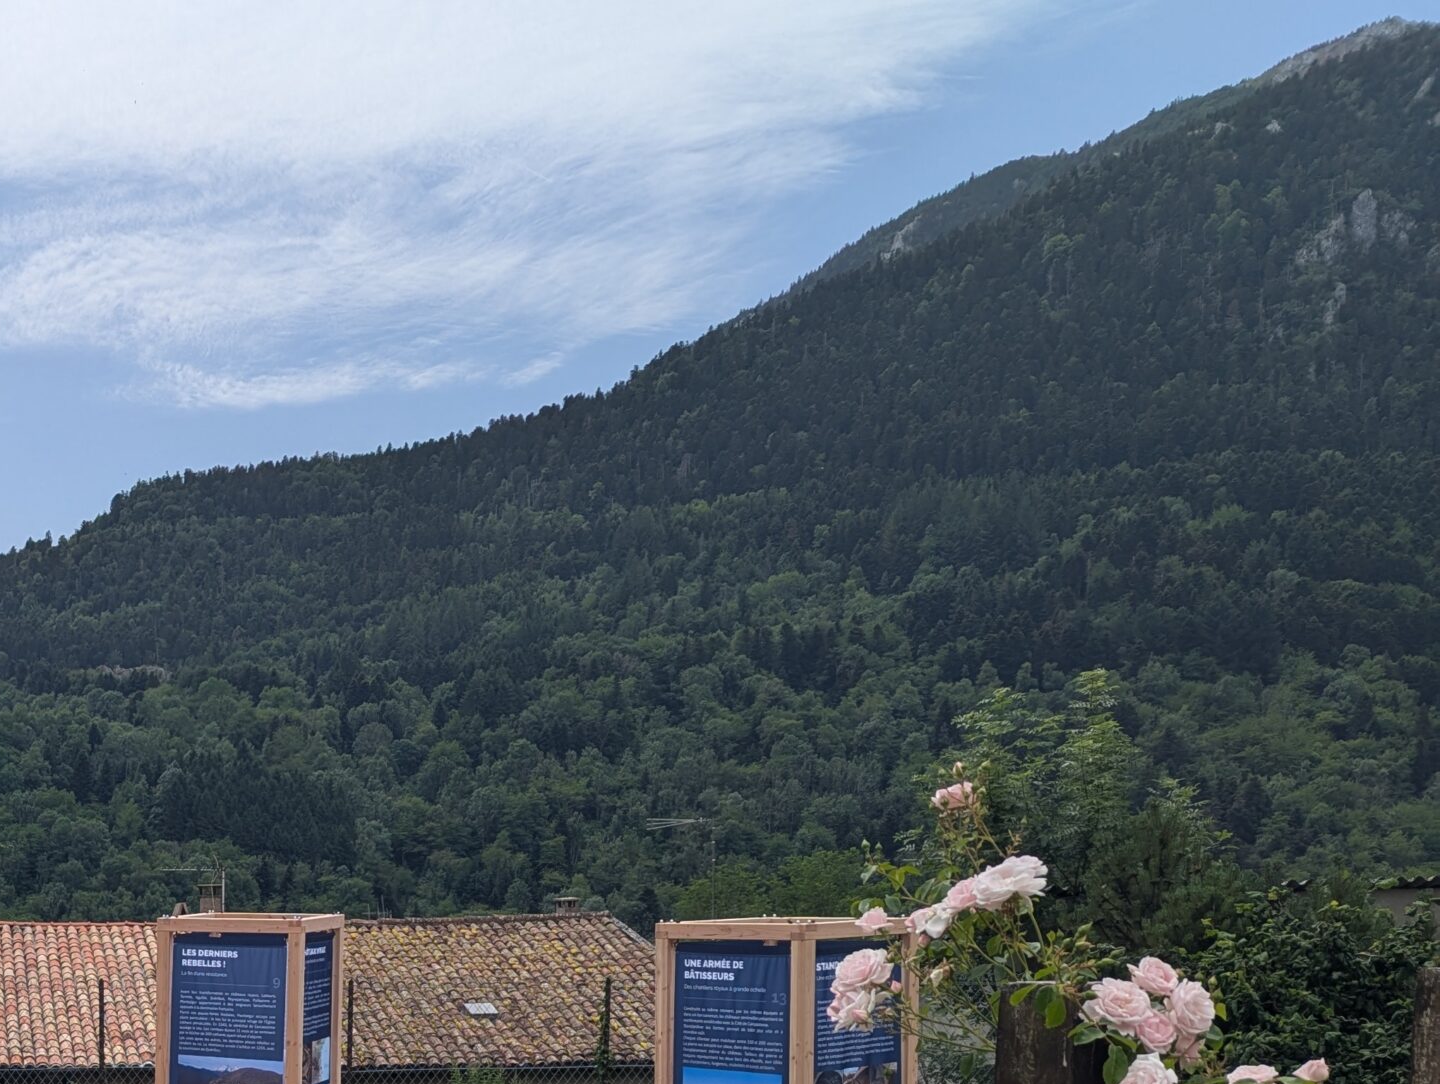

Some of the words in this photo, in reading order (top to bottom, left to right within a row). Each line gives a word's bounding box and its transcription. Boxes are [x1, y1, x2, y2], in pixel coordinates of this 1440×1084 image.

[182, 948, 197, 956] LES
[198, 949, 238, 958] DERNIERS
[182, 959, 222, 968] REBELLES
[684, 959, 702, 968] UNE
[703, 958, 731, 969] ARMÉE
[731, 961, 744, 969] DE
[684, 969, 735, 980] BÂTISSEURS
[273, 977, 280, 989] 9
[771, 993, 787, 1005] 13
